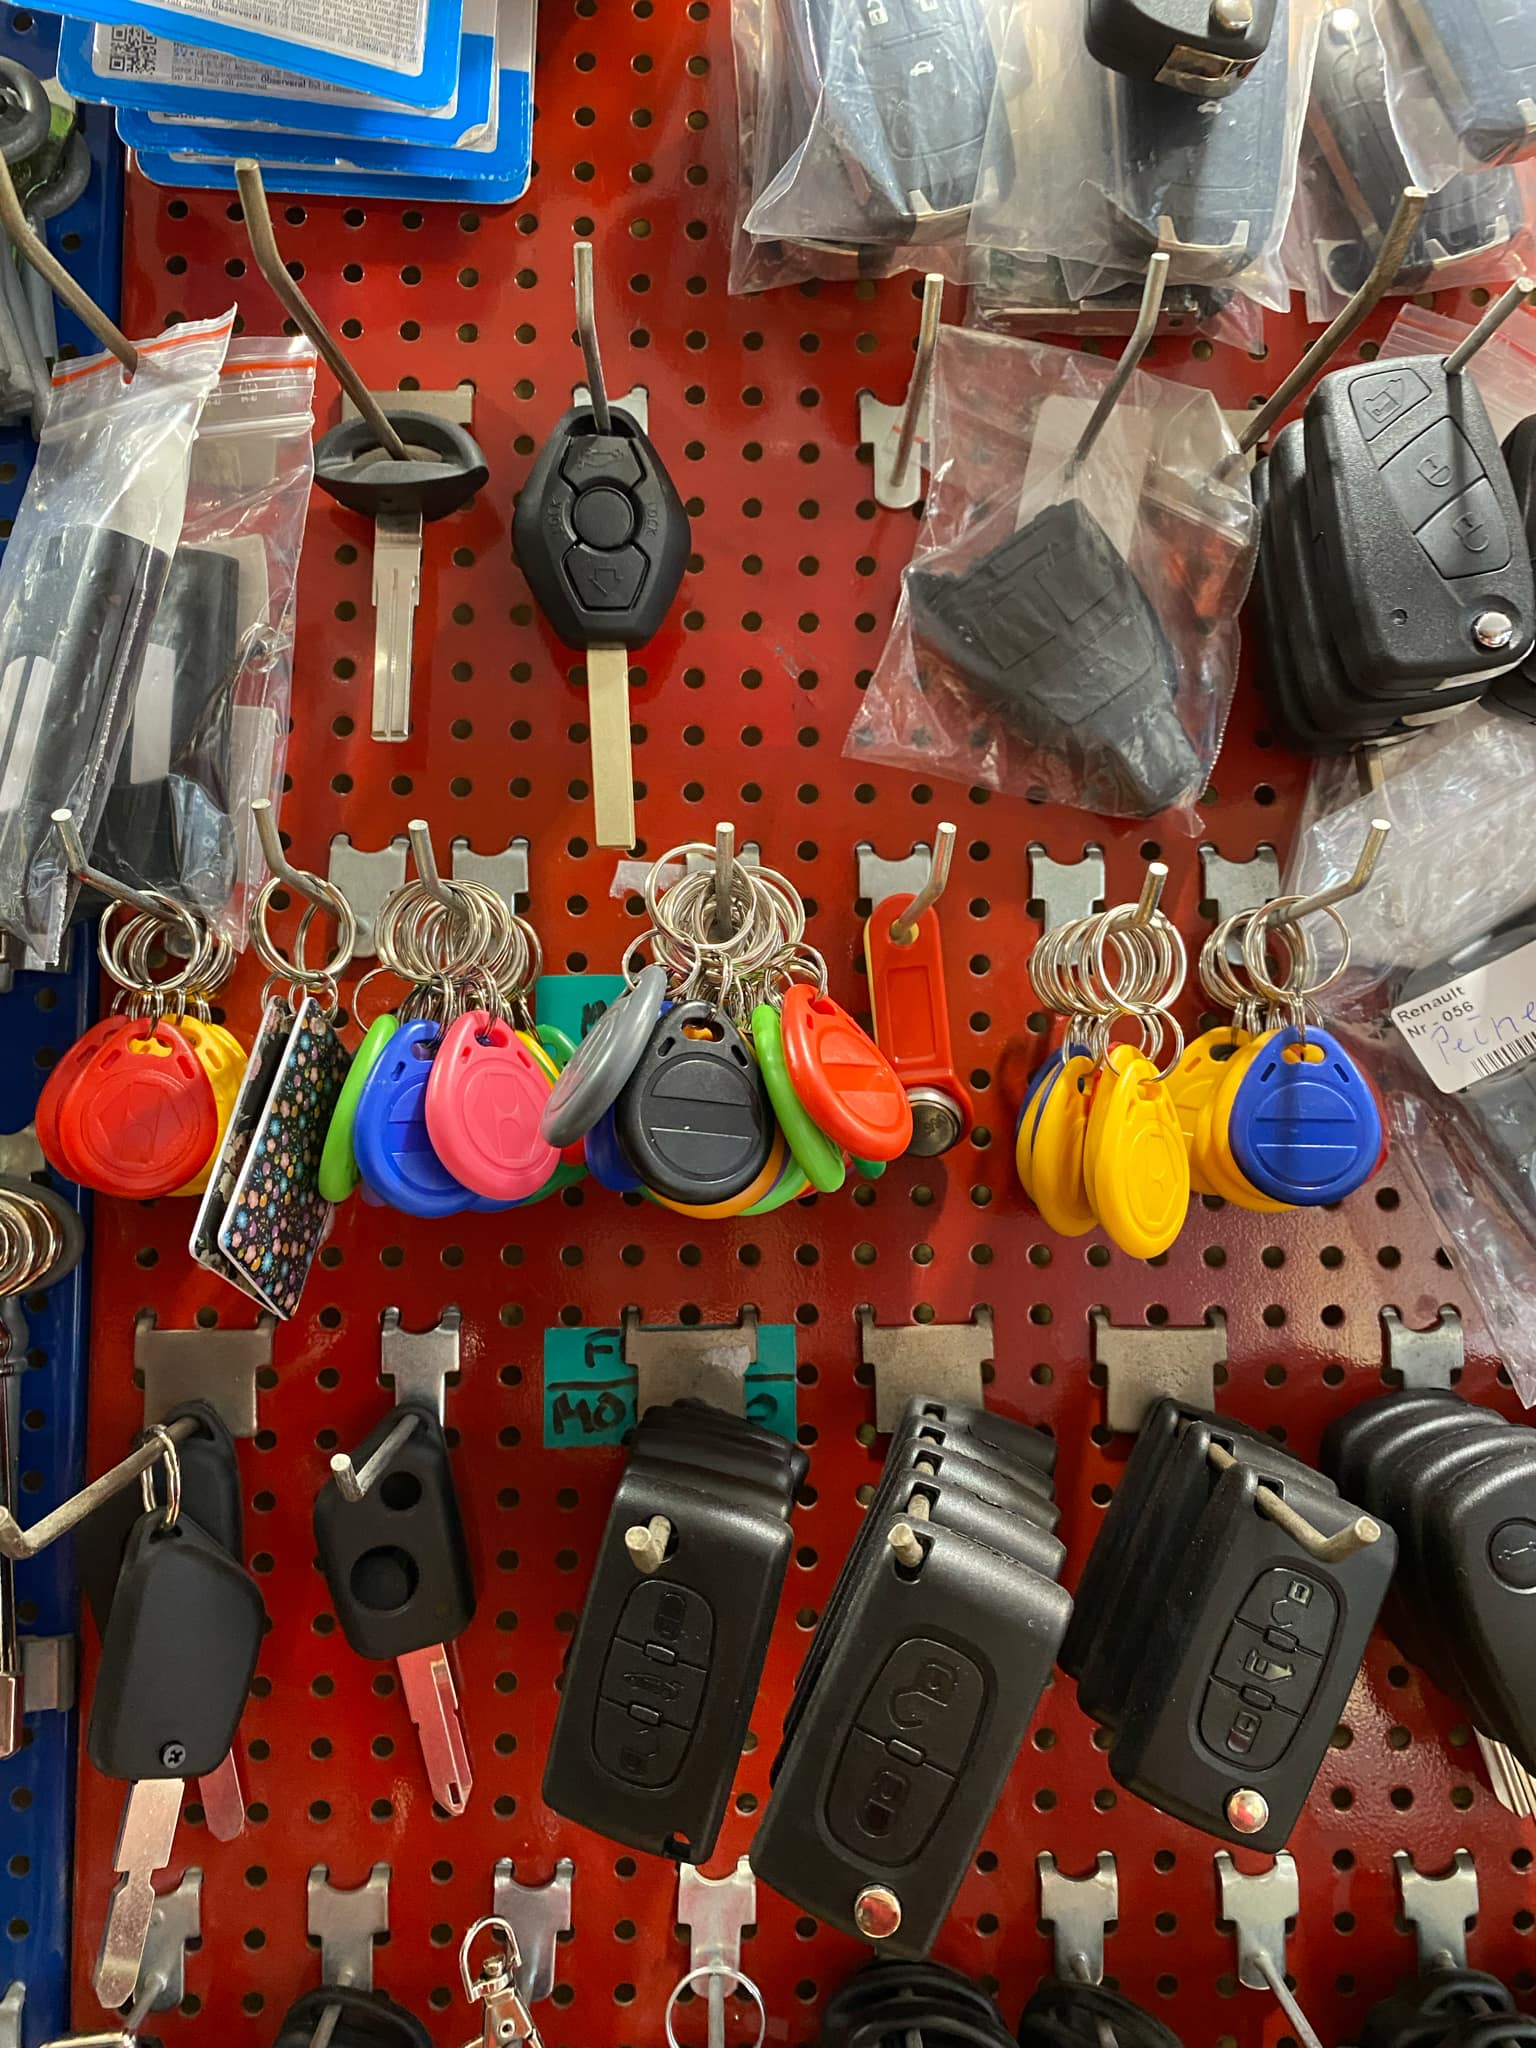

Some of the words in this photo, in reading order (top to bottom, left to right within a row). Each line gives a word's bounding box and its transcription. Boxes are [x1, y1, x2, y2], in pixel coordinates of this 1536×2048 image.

[1397, 986, 1465, 1023] Renault
[1407, 1021, 1427, 1038] Nr
[1442, 1001, 1474, 1022] 056
